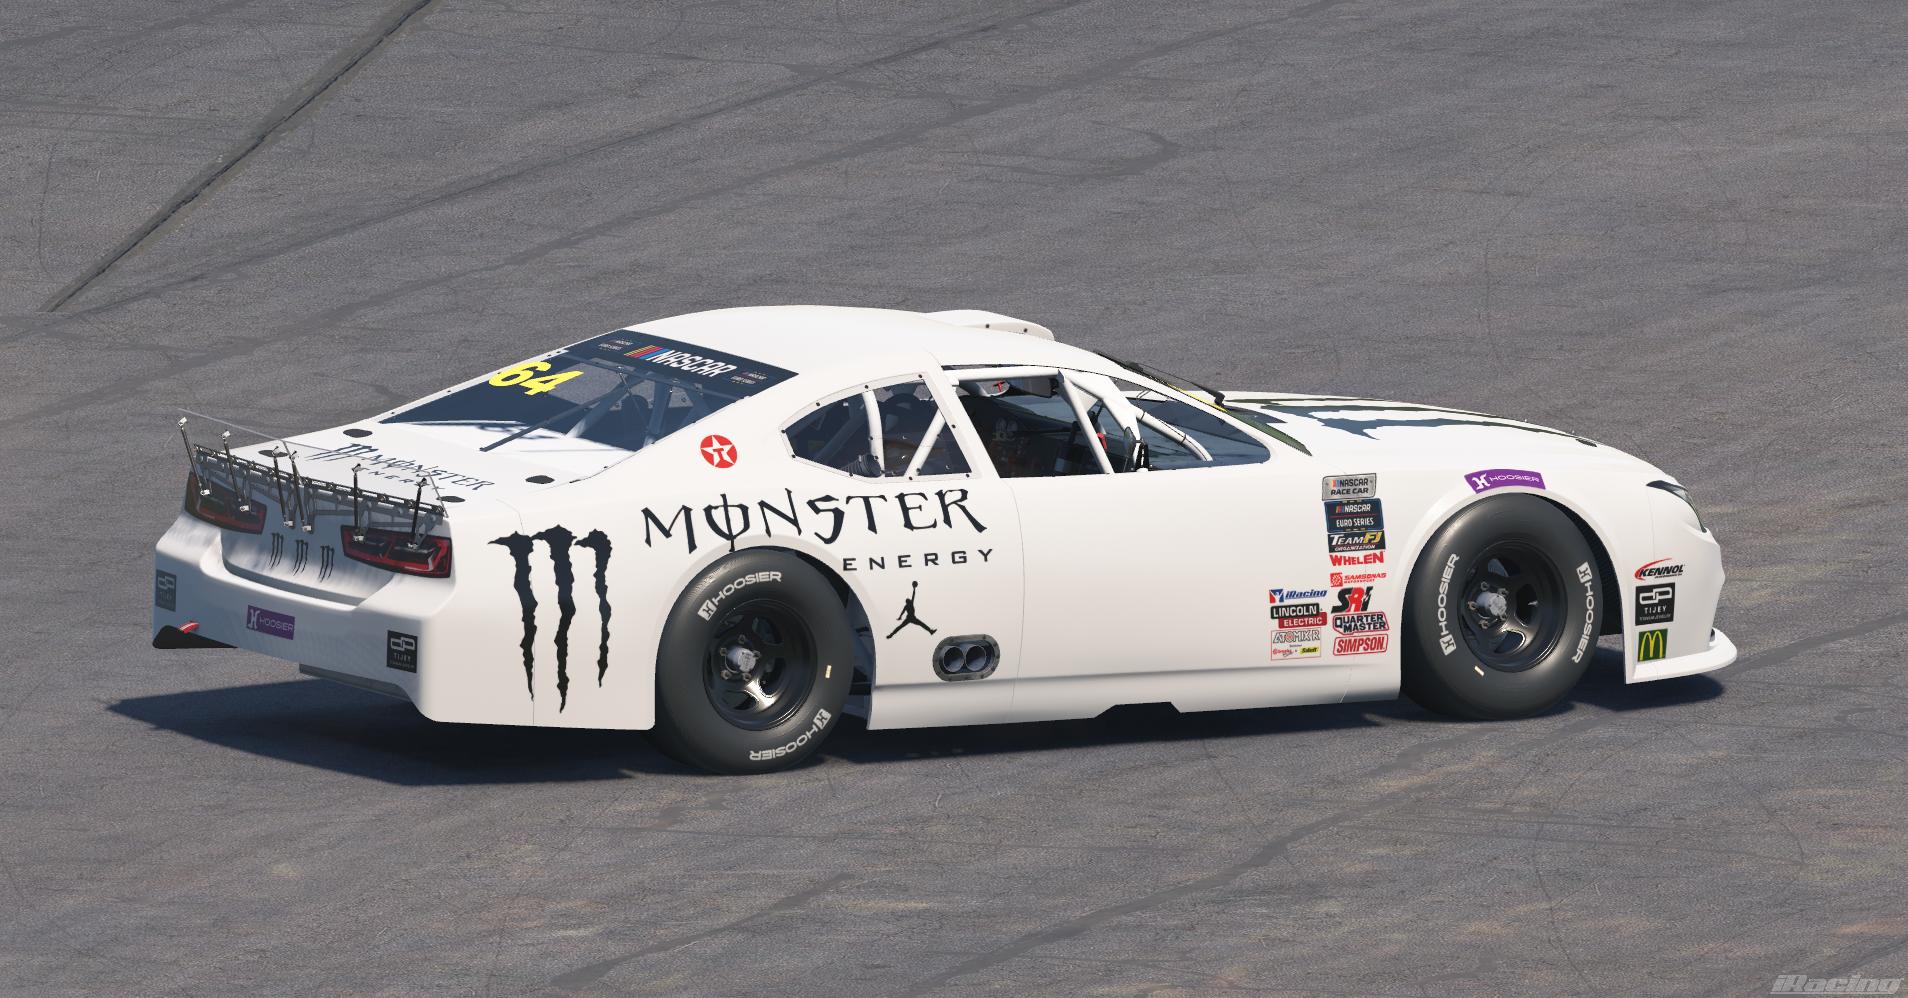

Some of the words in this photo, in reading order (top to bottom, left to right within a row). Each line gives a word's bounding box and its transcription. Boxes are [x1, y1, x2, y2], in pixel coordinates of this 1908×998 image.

[646, 350, 737, 378] NASCAR
[489, 361, 584, 395] 64
[1340, 478, 1369, 487] NASCAR
[1489, 474, 1541, 483] HOOSIER
[1344, 503, 1371, 513] NASCAR
[641, 488, 988, 554] MONSTER
[1336, 519, 1353, 527] EURO
[1354, 517, 1374, 526] SERIES
[843, 549, 993, 571] ENERGY
[1329, 551, 1385, 566] WHELEN
[1343, 573, 1387, 581] SAMSONAS
[1639, 565, 1684, 577] KENNOL
[713, 571, 782, 606] HOOSIER
[1285, 589, 1328, 600] iRacing
[1437, 553, 1460, 636] HOOSIER
[1273, 605, 1317, 617] LINCOLN
[1644, 605, 1667, 614] TIJEY
[260, 616, 294, 632] HOOSIER
[1283, 617, 1323, 627] ELECTRIC
[1335, 613, 1384, 629] QUARTER
[1343, 621, 1386, 634] MASTER
[1571, 582, 1595, 664] HOOSIER
[1336, 637, 1384, 653] SIMPSON
[749, 727, 821, 760] HOOSIER
